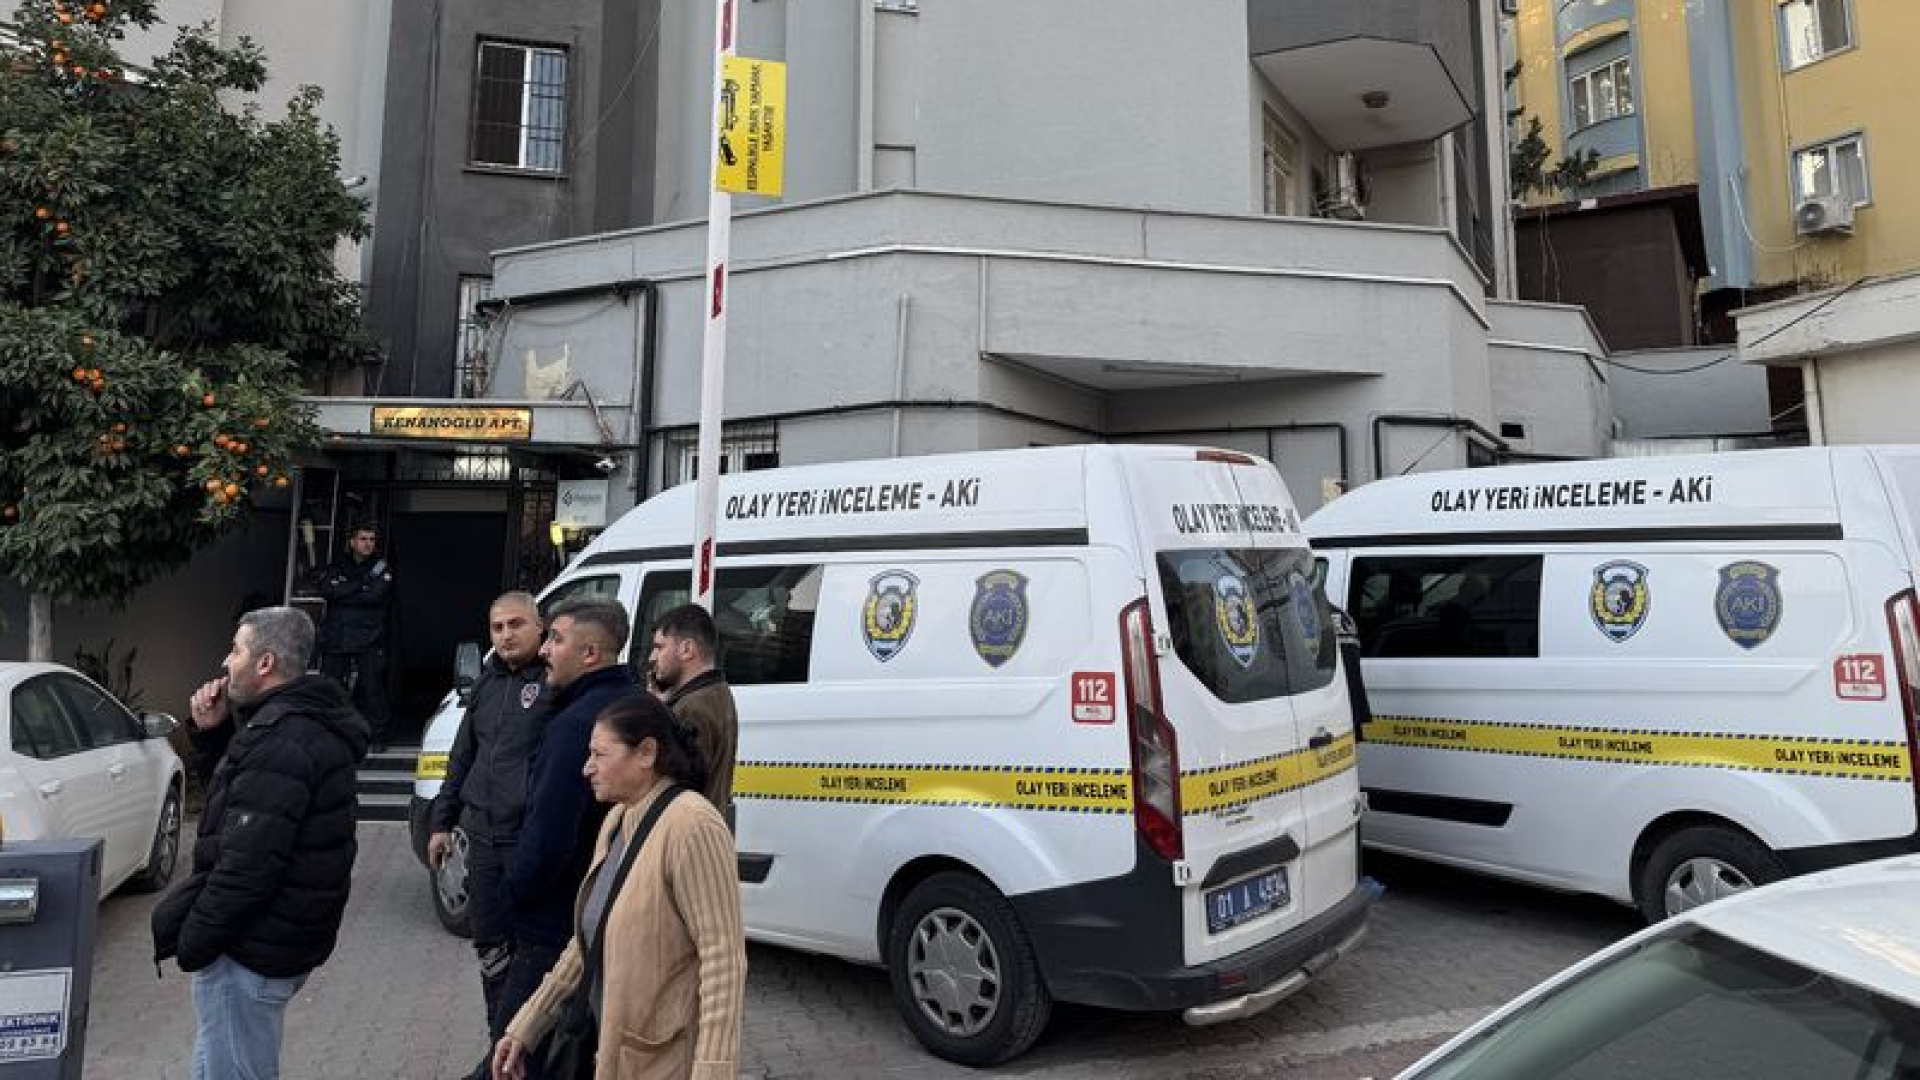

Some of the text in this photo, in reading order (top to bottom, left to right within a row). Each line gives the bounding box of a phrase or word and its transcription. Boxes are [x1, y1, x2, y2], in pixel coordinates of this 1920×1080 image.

[725, 493, 774, 519] OLAY
[1431, 489, 1480, 512] OLAY
[1842, 660, 1876, 680] 112
[1079, 678, 1108, 702] 112
[1559, 736, 1581, 749] OLAY
[1775, 748, 1805, 763] OLAY
[820, 774, 843, 789] OLAY
[1016, 779, 1043, 795] OLAY
[1217, 892, 1234, 918] 01
